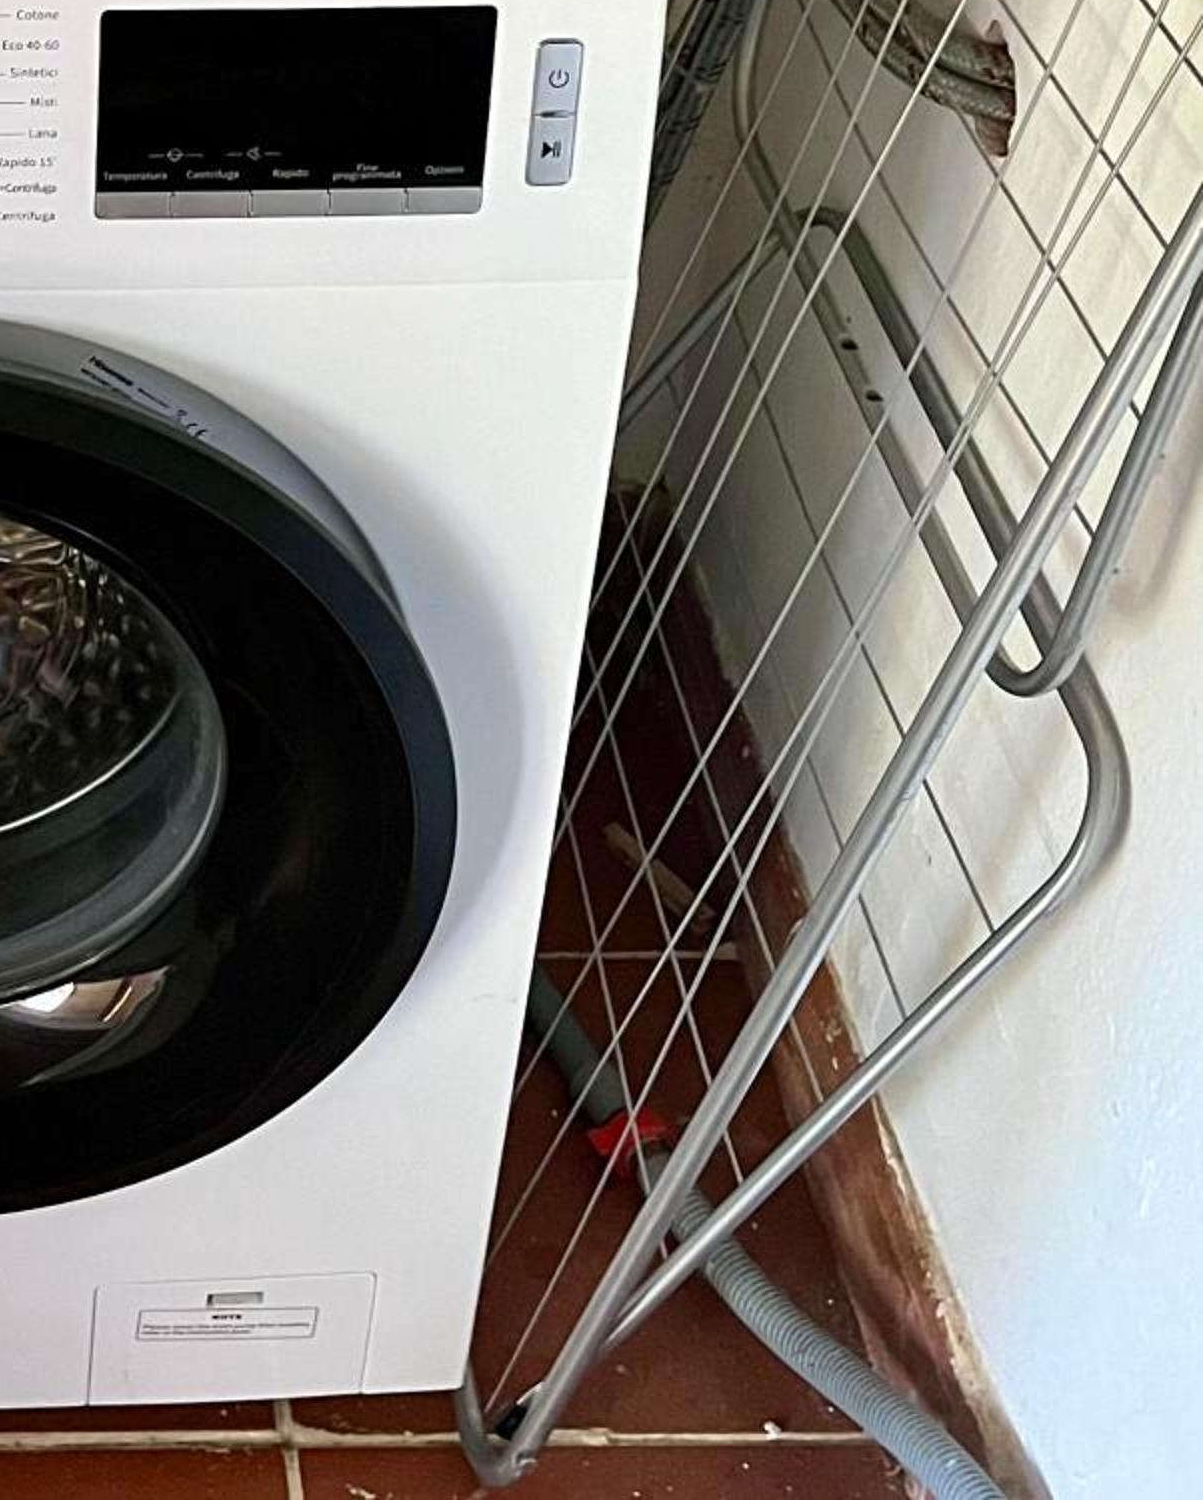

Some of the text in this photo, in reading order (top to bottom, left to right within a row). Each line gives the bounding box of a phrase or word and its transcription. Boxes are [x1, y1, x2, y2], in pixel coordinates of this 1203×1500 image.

[16, 9, 60, 20] Cotone
[2, 40, 24, 51] Eco
[28, 129, 58, 139] Lana
